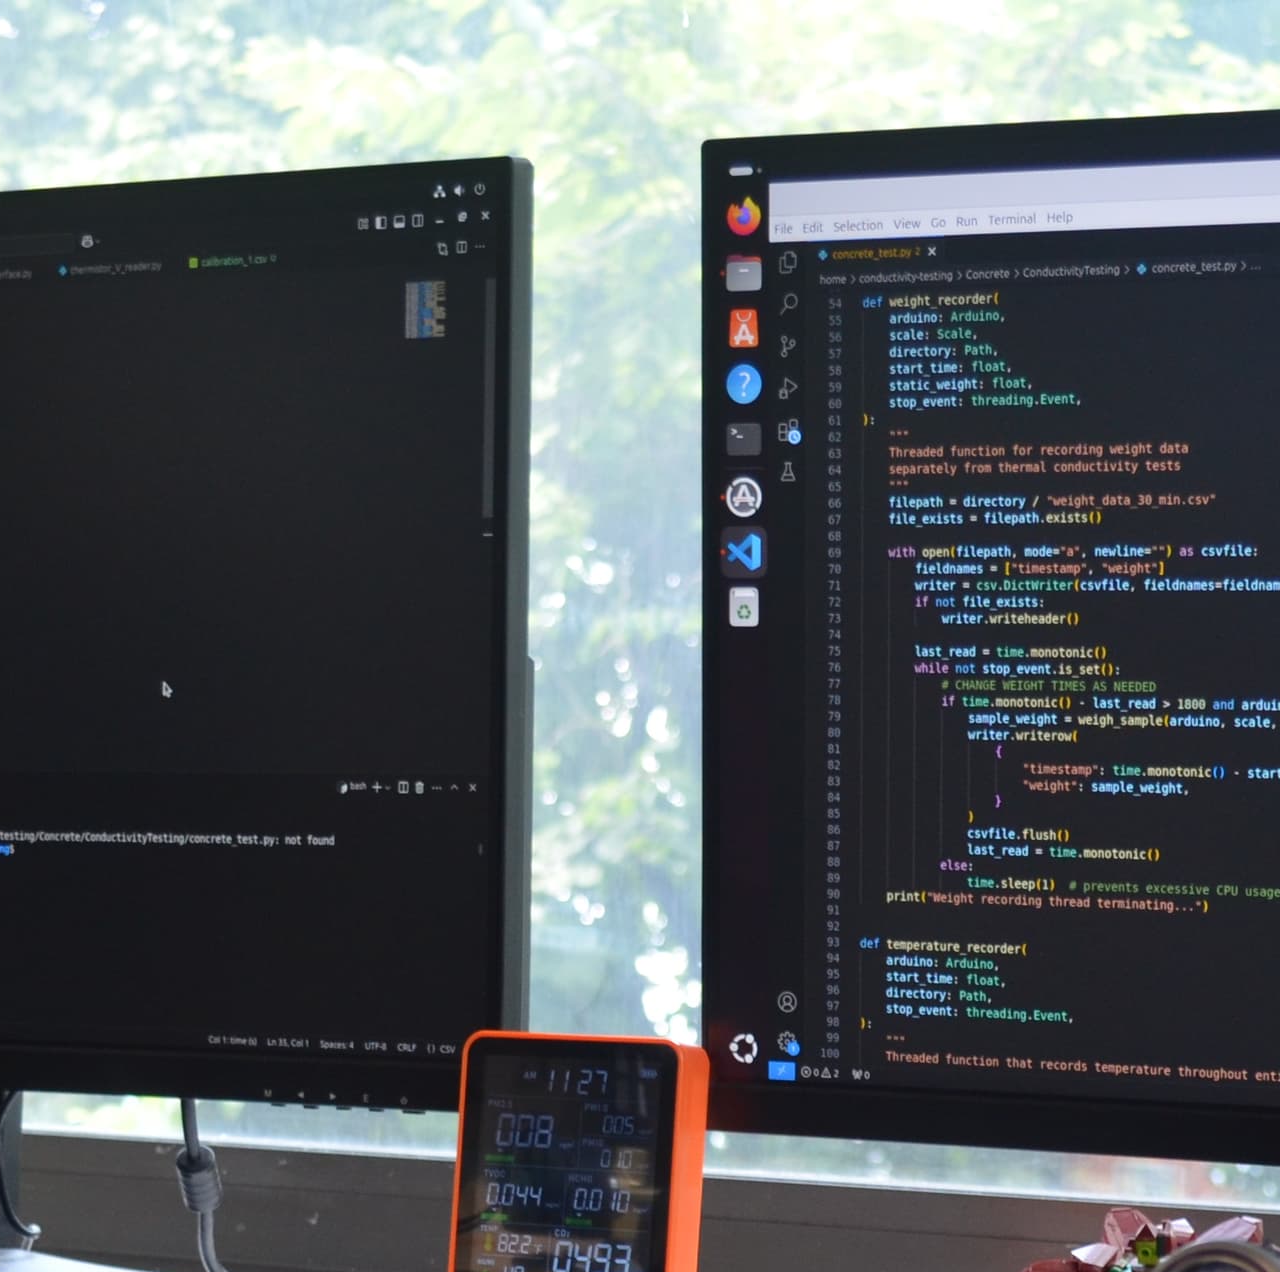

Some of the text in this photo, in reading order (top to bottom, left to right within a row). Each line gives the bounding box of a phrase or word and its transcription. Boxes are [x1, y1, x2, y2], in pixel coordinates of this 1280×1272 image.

[774, 210, 1074, 235] File Edit Selection View Go Run Terminal Help
[831, 247, 913, 262] concrete_test.py
[820, 259, 1237, 286] home conductivity-testing Concrete ConductivityTesting concrete_test.py
[862, 296, 883, 308] def
[889, 310, 1005, 325] arduino: Arduino,
[889, 344, 998, 359] directory: Path,
[889, 394, 1080, 411] stop_event: threading.Event,
[889, 442, 1188, 457] Threaded function for recording weight data
[889, 460, 1180, 476] separately from thermal conductivity tests
[889, 496, 943, 509] filepath
[963, 496, 1026, 509] directory
[889, 513, 963, 527] file_exists
[888, 546, 916, 558] with
[1024, 545, 1086, 557] mode="a",
[1094, 545, 1172, 557] newline="")
[1179, 547, 1194, 556] as
[1201, 544, 1258, 557] csvfile:
[916, 562, 1164, 576] fieldnames ["timestamp", "weight"]
[914, 579, 956, 591] writer
[915, 646, 976, 660] last_read
[914, 659, 949, 673] while
[955, 663, 975, 674] not
[955, 679, 1156, 692] CHANGE WEIGHT TIMES AS NEEDED
[942, 695, 955, 707] if
[1093, 697, 1157, 712] last_read
[1177, 698, 1206, 709] 1800
[1213, 698, 1236, 710] and
[969, 713, 1057, 727] sample_weight
[1234, 716, 1276, 729] scale,
[285, 835, 303, 847] not
[307, 834, 336, 847] found
[940, 859, 973, 872] else:
[967, 877, 1280, 899] time.sleep(1) prevents excessive CPU usage
[887, 891, 973, 905] print("Weight
[981, 895, 1042, 908] recording
[1049, 896, 1090, 907] thread
[439, 1044, 456, 1055] CSV
[886, 1051, 939, 1064] Threaded
[946, 1053, 999, 1067] function
[1006, 1057, 1032, 1069] that
[1040, 1060, 1088, 1072] records
[1095, 1063, 1171, 1077] temperature
[1178, 1067, 1248, 1081] throughout
[495, 1112, 555, 1149] 008
[485, 1182, 543, 1208] 0.044
